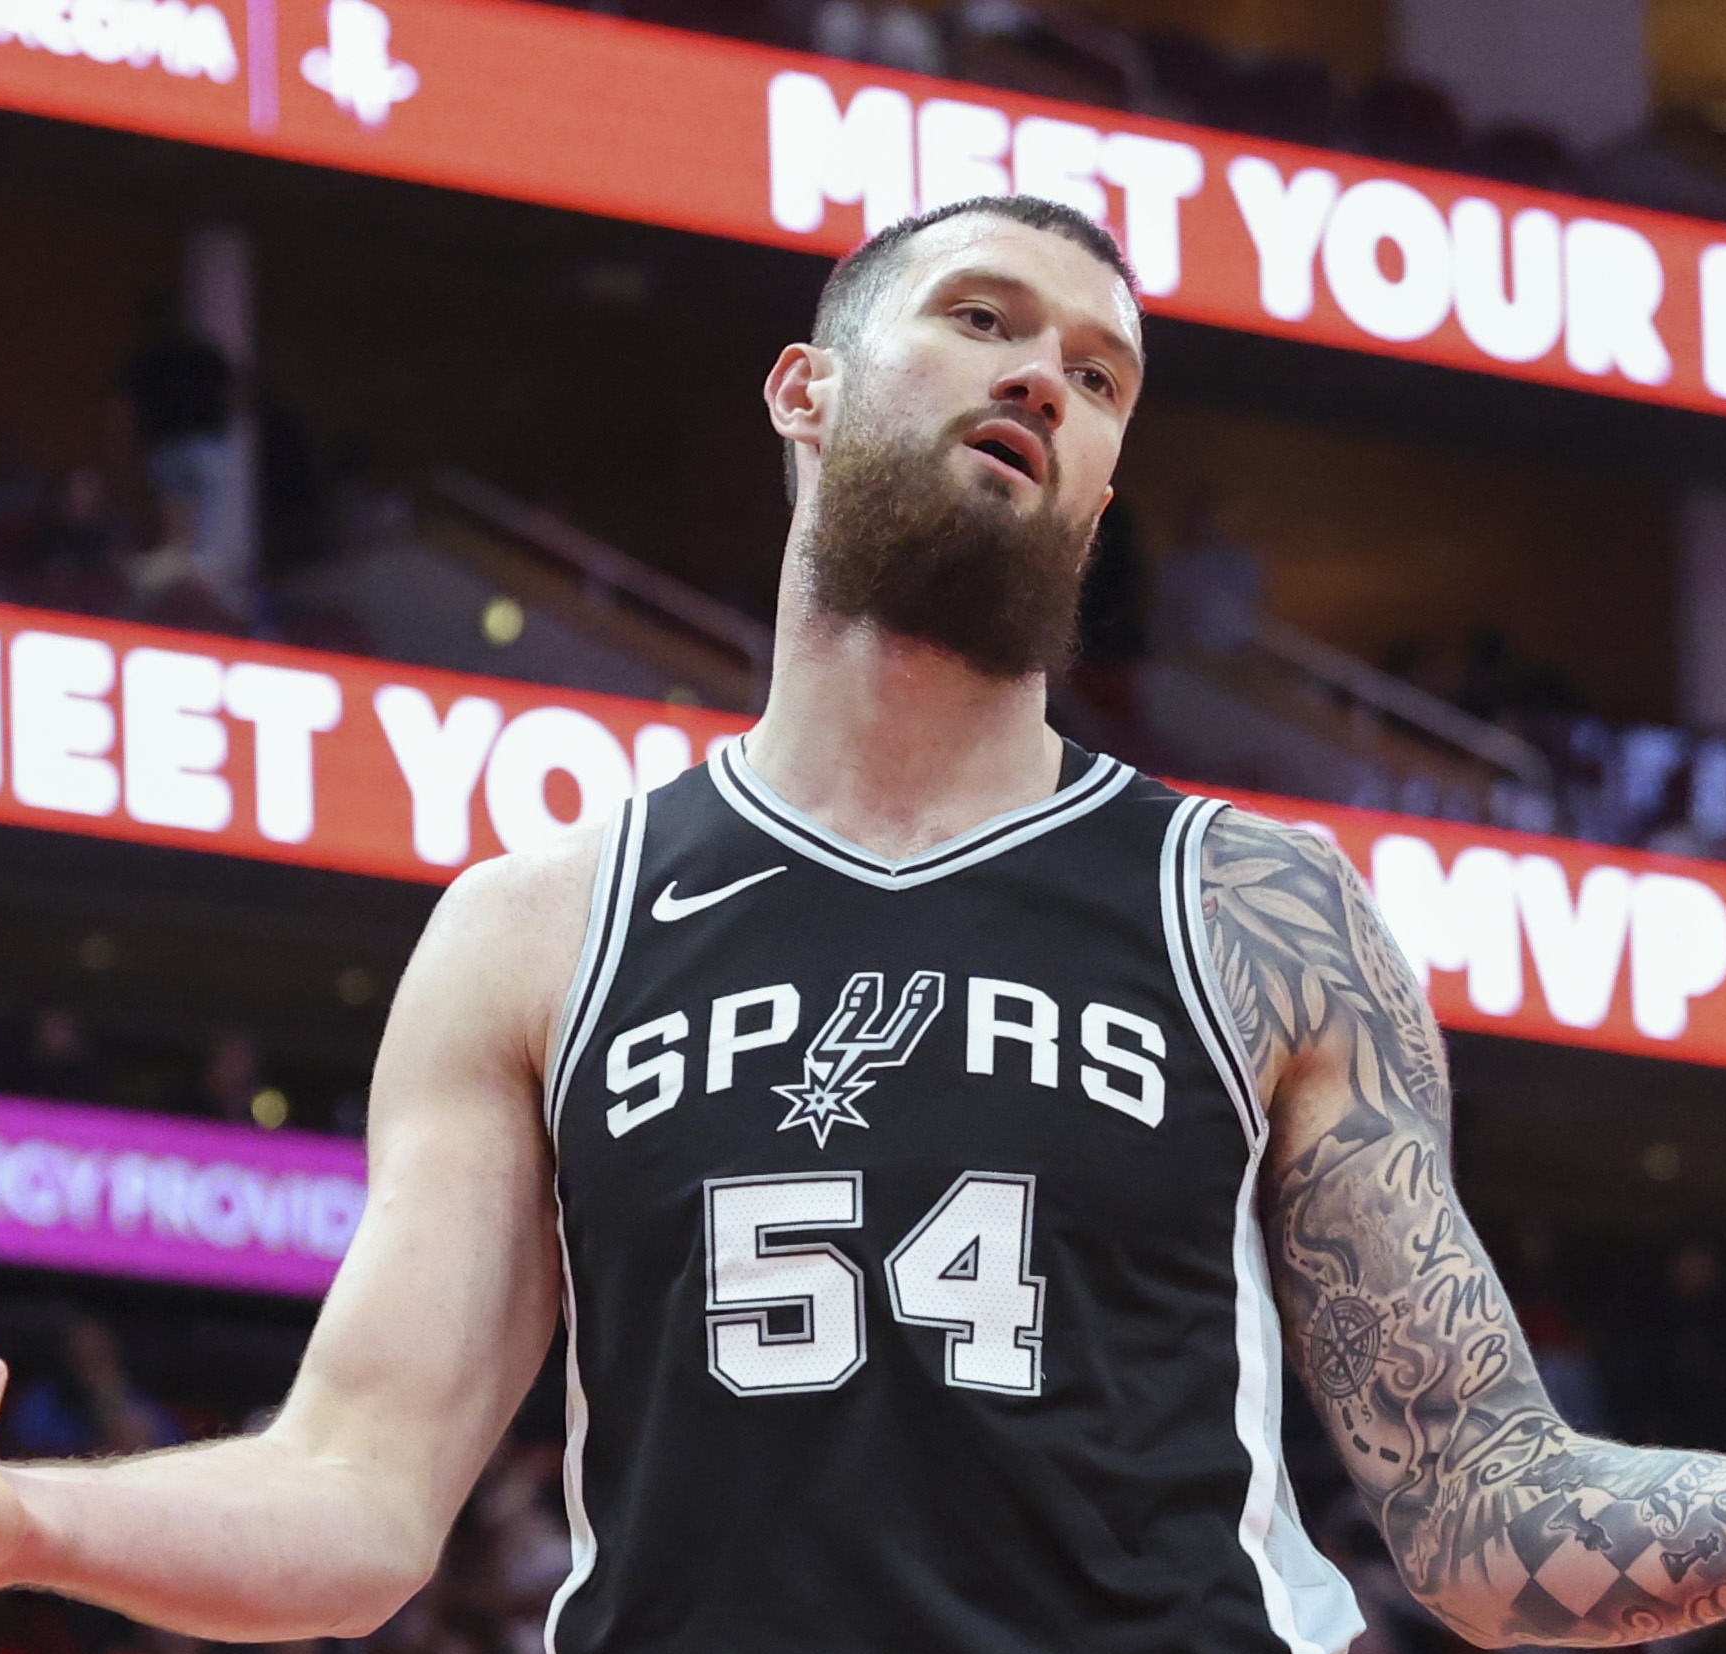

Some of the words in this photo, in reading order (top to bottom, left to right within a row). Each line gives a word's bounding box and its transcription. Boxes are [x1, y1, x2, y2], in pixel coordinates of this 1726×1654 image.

[1225, 155, 1671, 387] YOUR
[606, 971, 1167, 1149] SPURS
[703, 1170, 1047, 1397] 54
